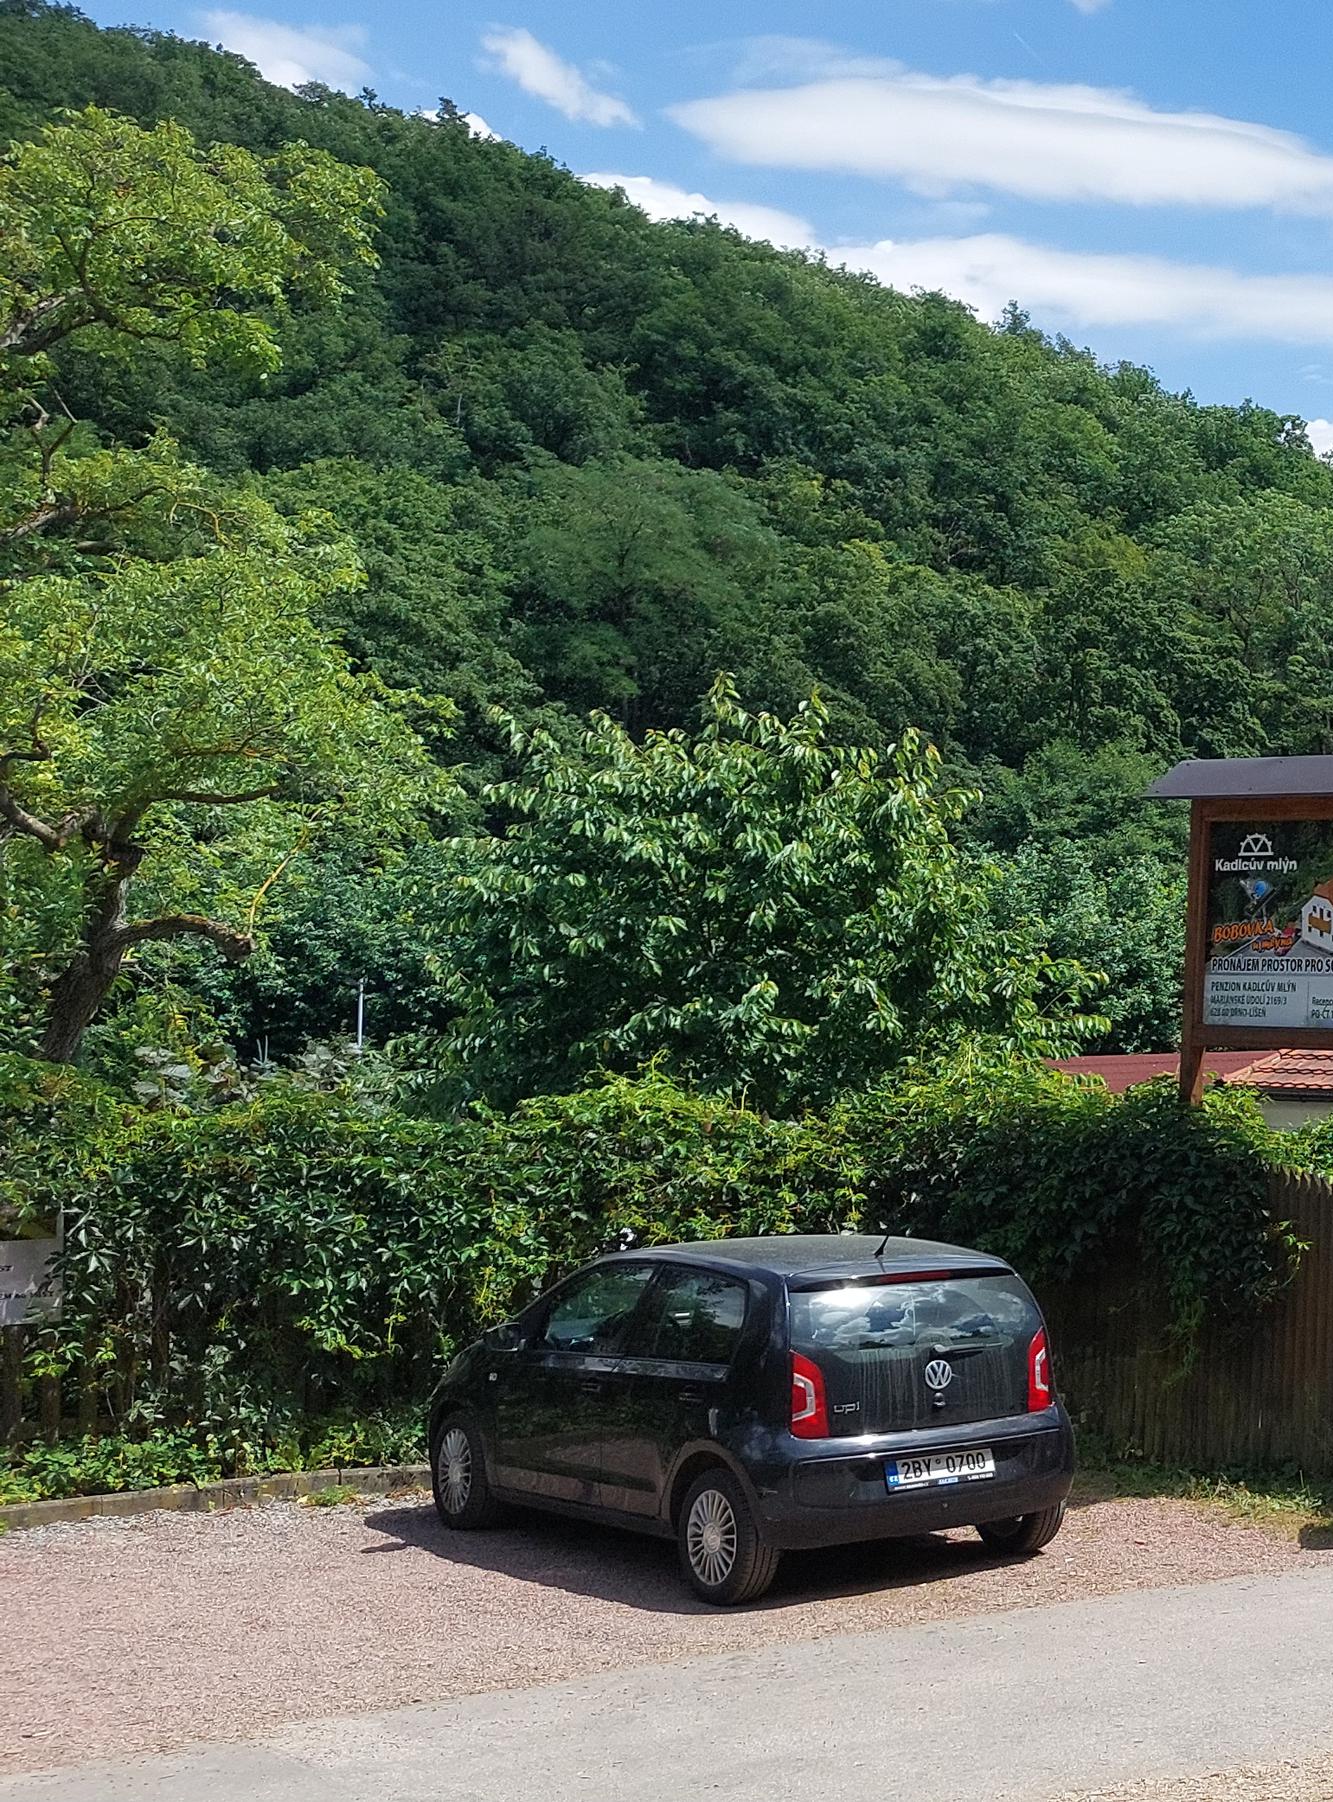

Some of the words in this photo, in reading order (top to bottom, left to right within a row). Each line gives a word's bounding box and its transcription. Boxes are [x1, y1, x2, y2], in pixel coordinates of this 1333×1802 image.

[1266, 856, 1297, 874] mlýn
[1213, 919, 1275, 943] BOBOVKA
[1212, 955, 1260, 972] PRONÁJEM
[1261, 958, 1303, 972] PROSTOR
[1304, 959, 1324, 972] PRO
[1211, 981, 1240, 991] PENZION
[1277, 980, 1296, 992] MLÝN
[833, 1401, 860, 1414] up!
[901, 1459, 931, 1480] 2BY
[945, 1452, 986, 1474] 0700
